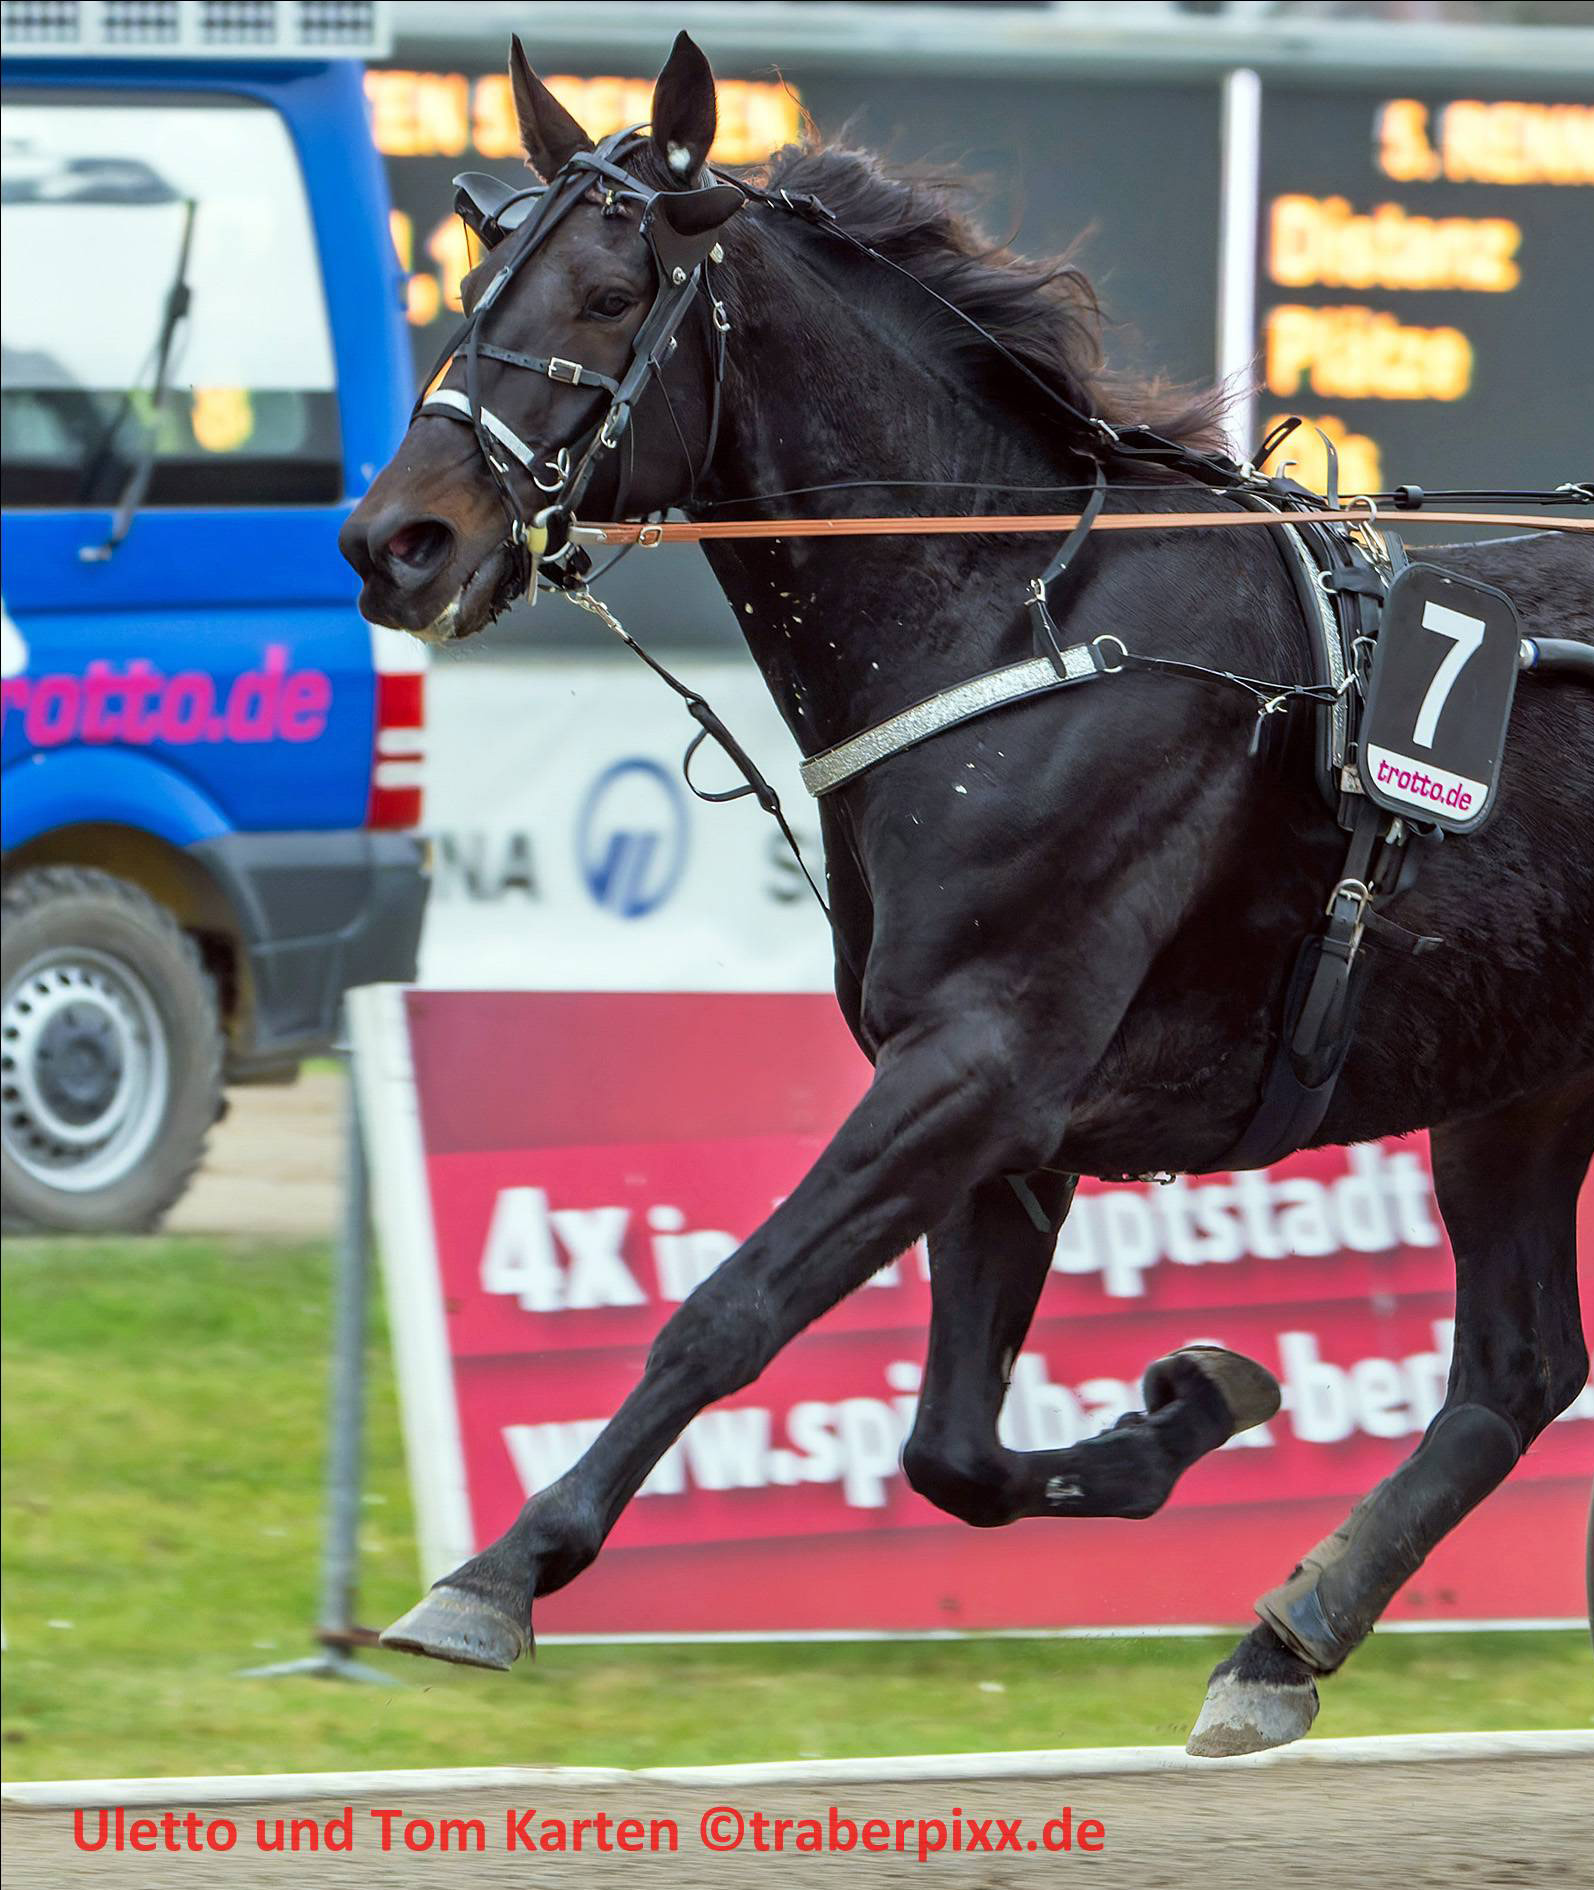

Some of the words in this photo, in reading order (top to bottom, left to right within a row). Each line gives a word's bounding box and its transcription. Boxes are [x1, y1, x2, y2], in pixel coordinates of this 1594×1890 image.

[1267, 193, 1522, 292] Distanz
[1412, 600, 1487, 750] 7
[1376, 759, 1473, 811] trotto.de
[477, 1185, 649, 1313] 4x
